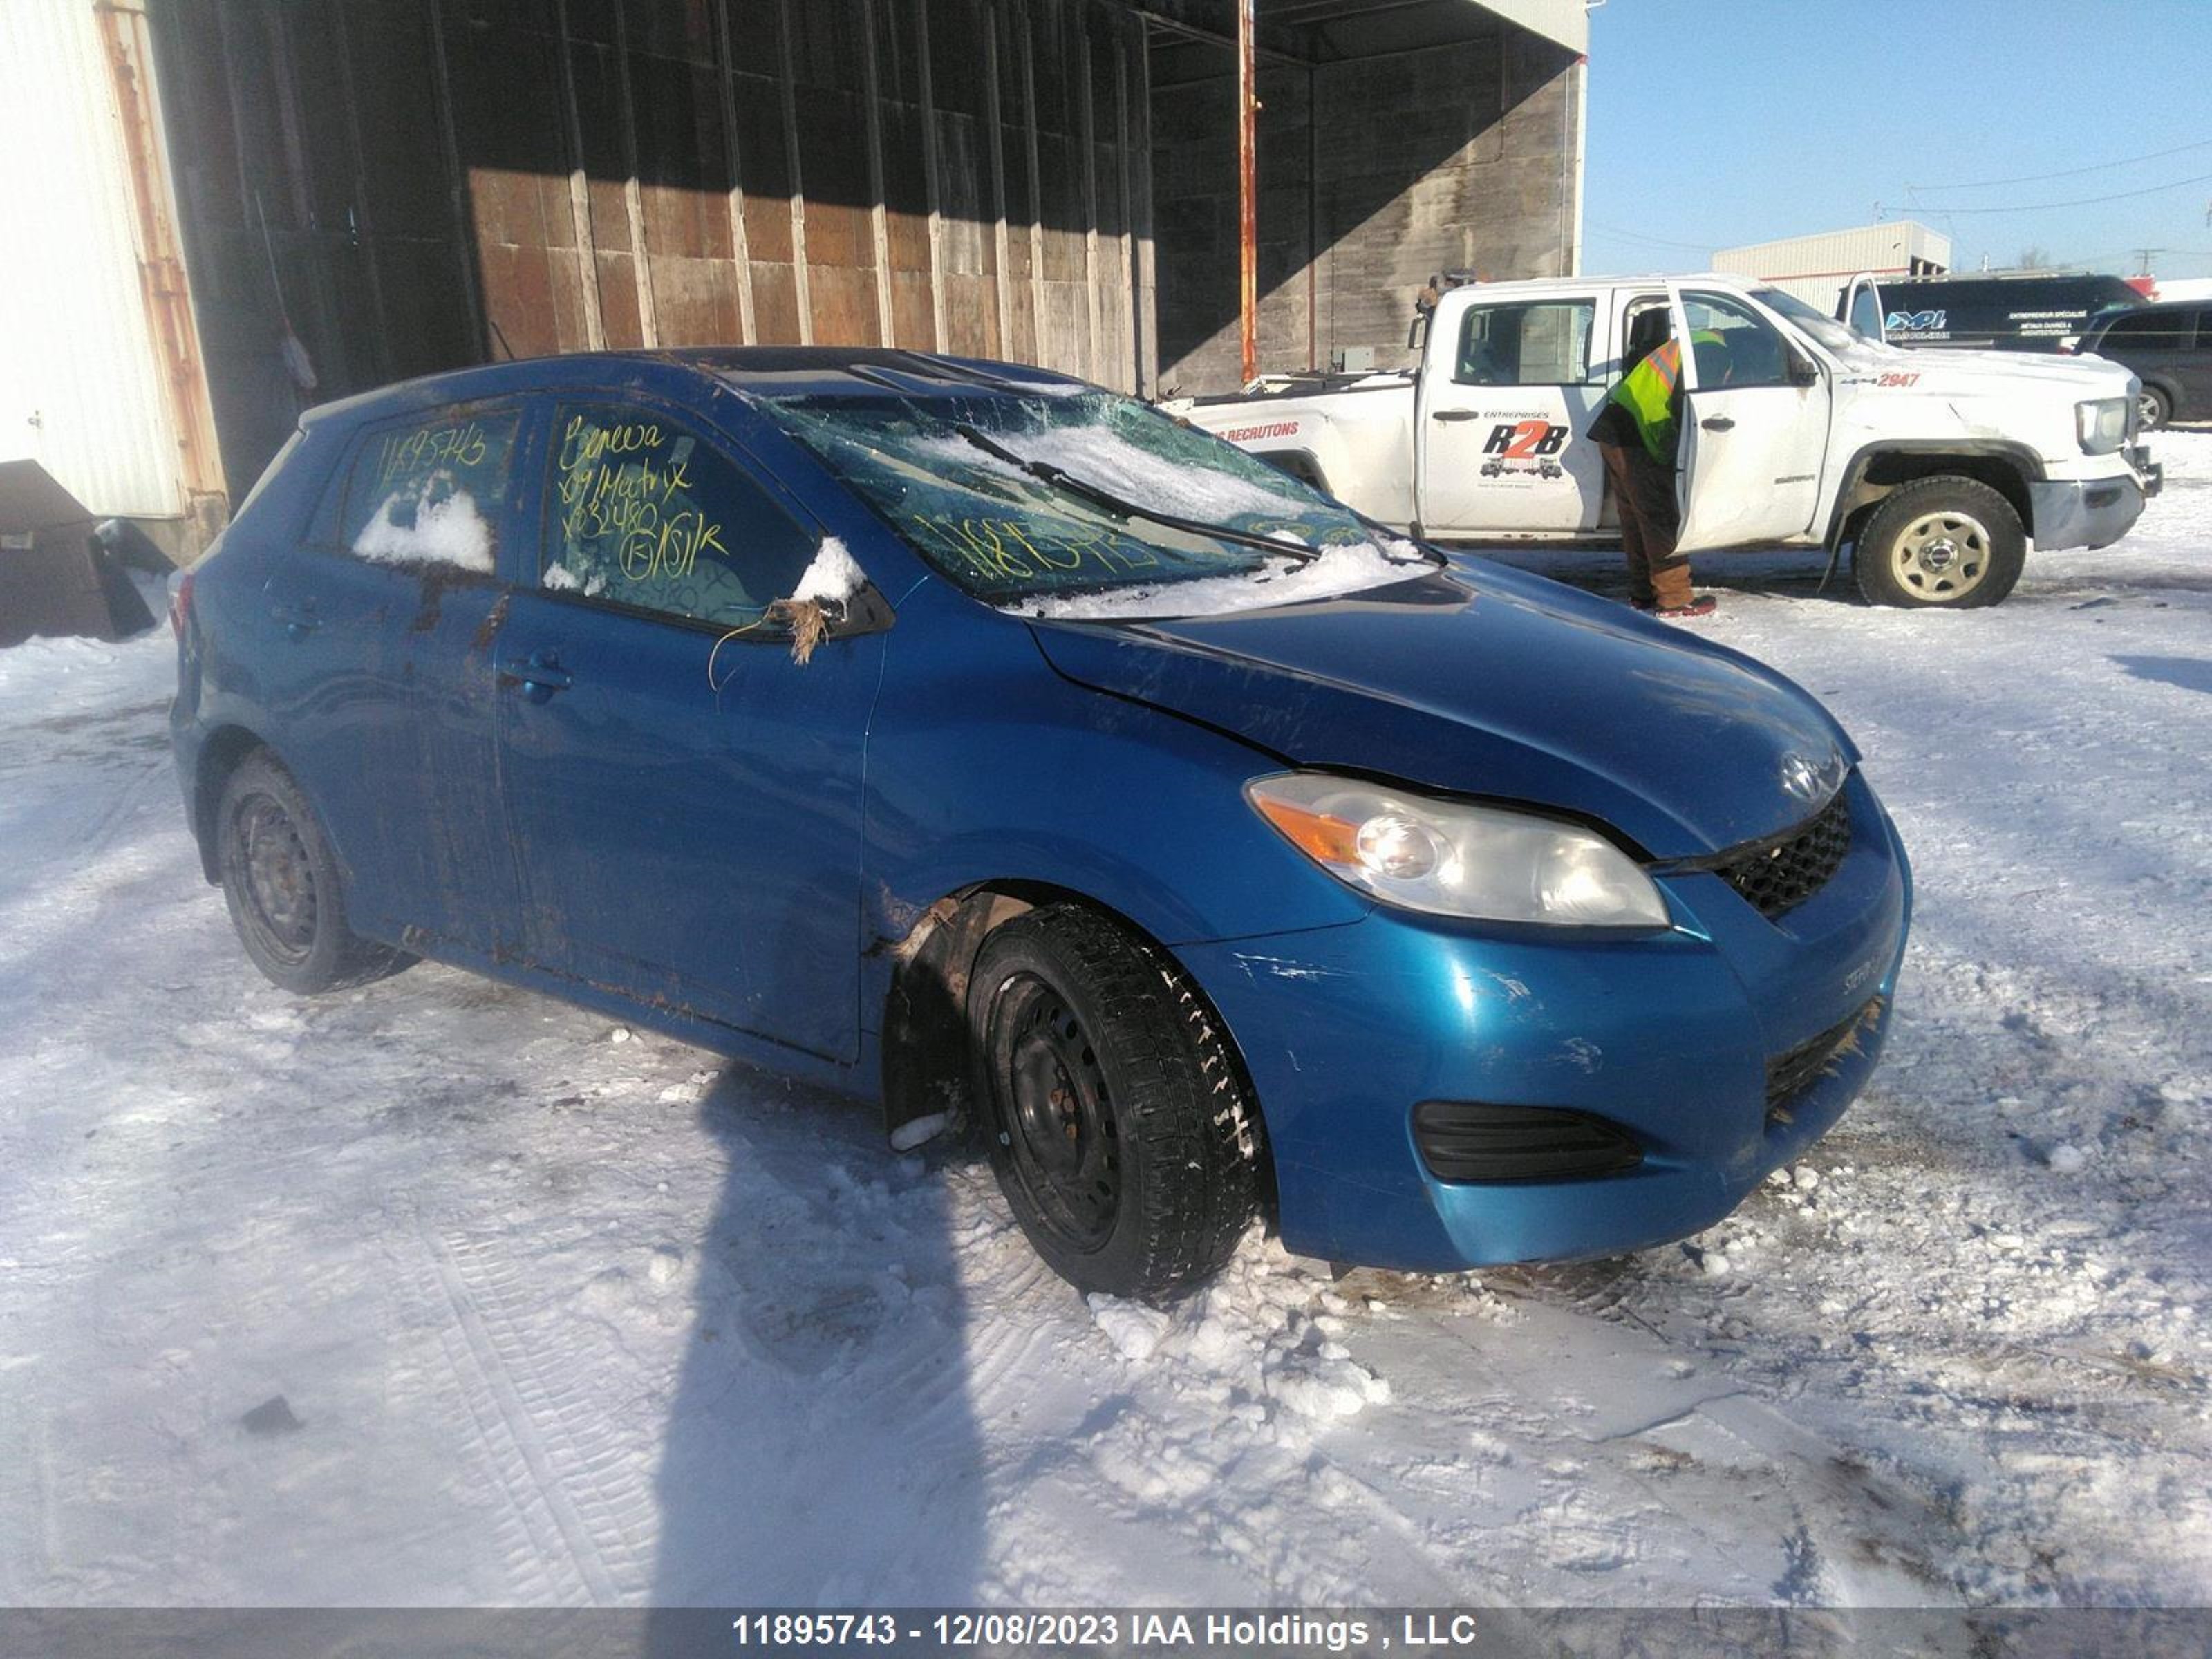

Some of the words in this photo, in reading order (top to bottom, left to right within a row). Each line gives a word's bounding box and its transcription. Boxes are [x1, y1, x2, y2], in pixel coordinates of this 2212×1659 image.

[1877, 373, 1921, 387] 2947
[1226, 420, 1299, 442] RECRUTONS
[1481, 420, 1569, 459] R2B
